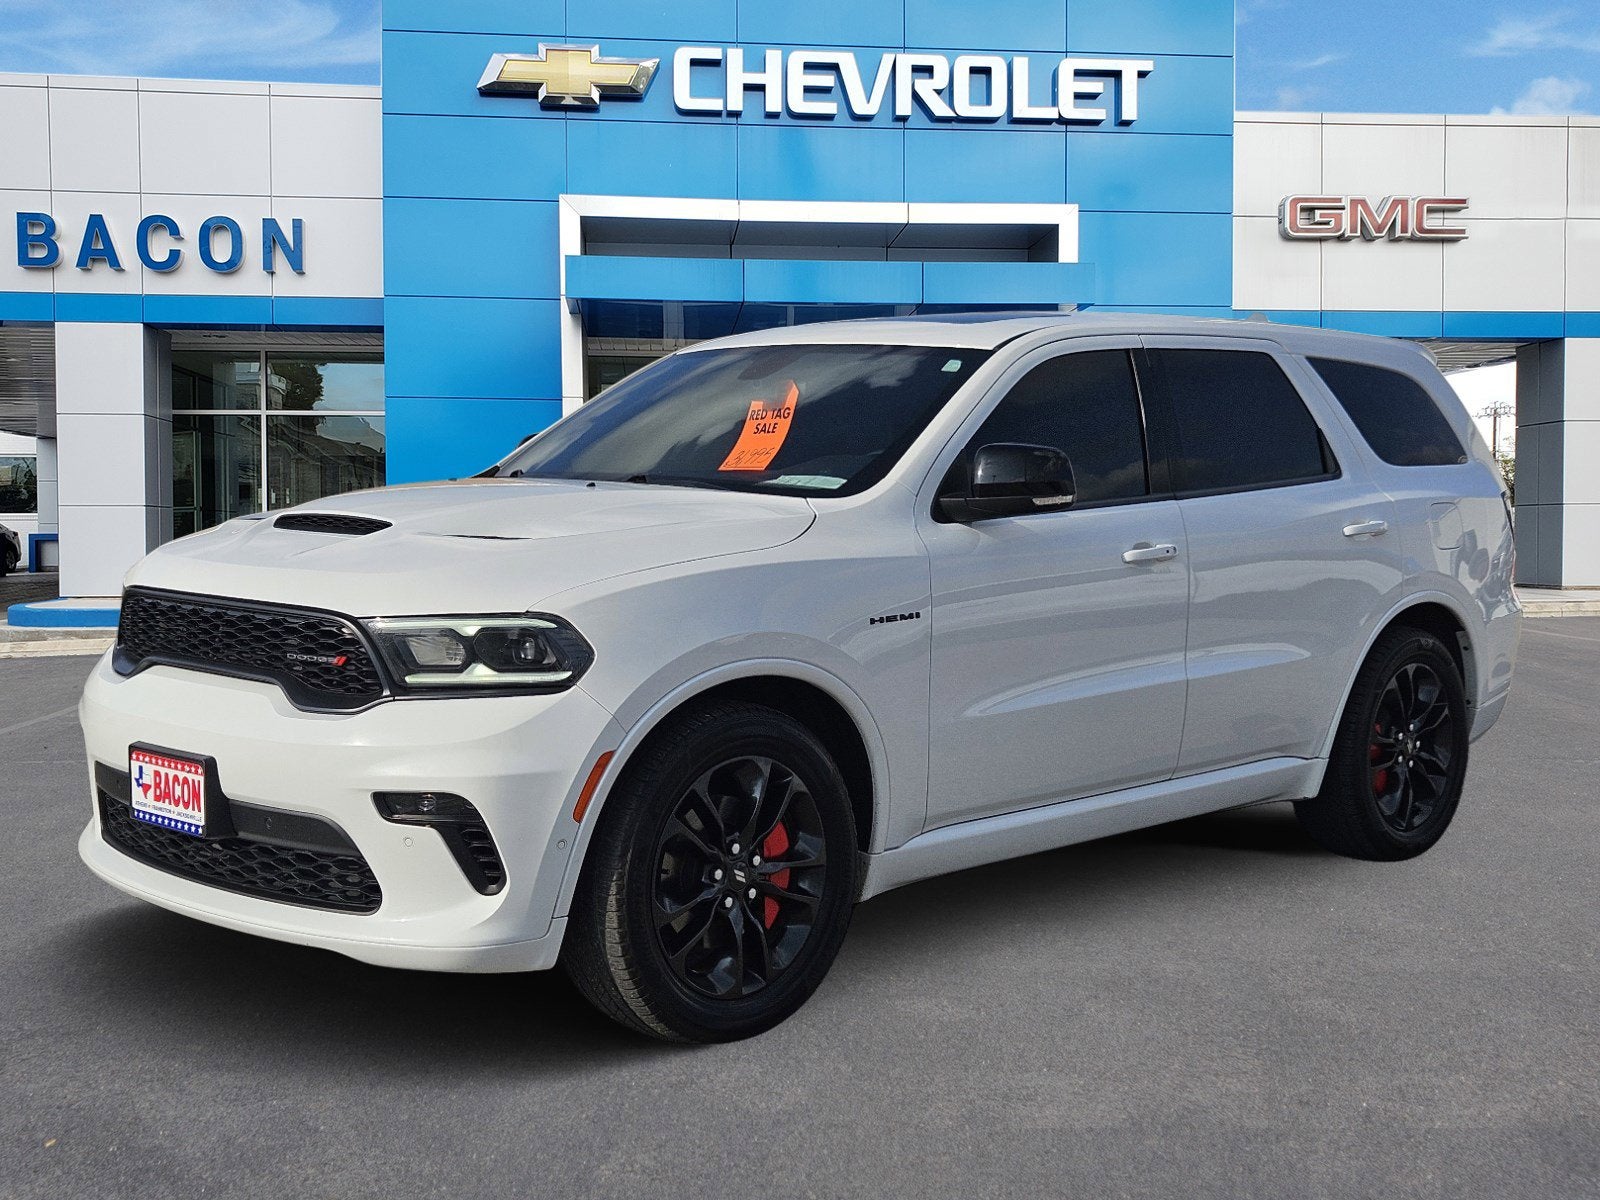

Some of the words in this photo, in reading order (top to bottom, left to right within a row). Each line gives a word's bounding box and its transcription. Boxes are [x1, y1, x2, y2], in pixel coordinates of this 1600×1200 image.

[673, 46, 1154, 126] CHEVROLET
[1278, 194, 1469, 241] GMC
[16, 211, 306, 275] BACON
[749, 409, 767, 421] RED
[770, 407, 791, 420] TAG
[753, 423, 778, 435] SALE
[869, 611, 921, 625] HEMI
[286, 653, 337, 664] DODGE
[153, 769, 202, 813] BACON
